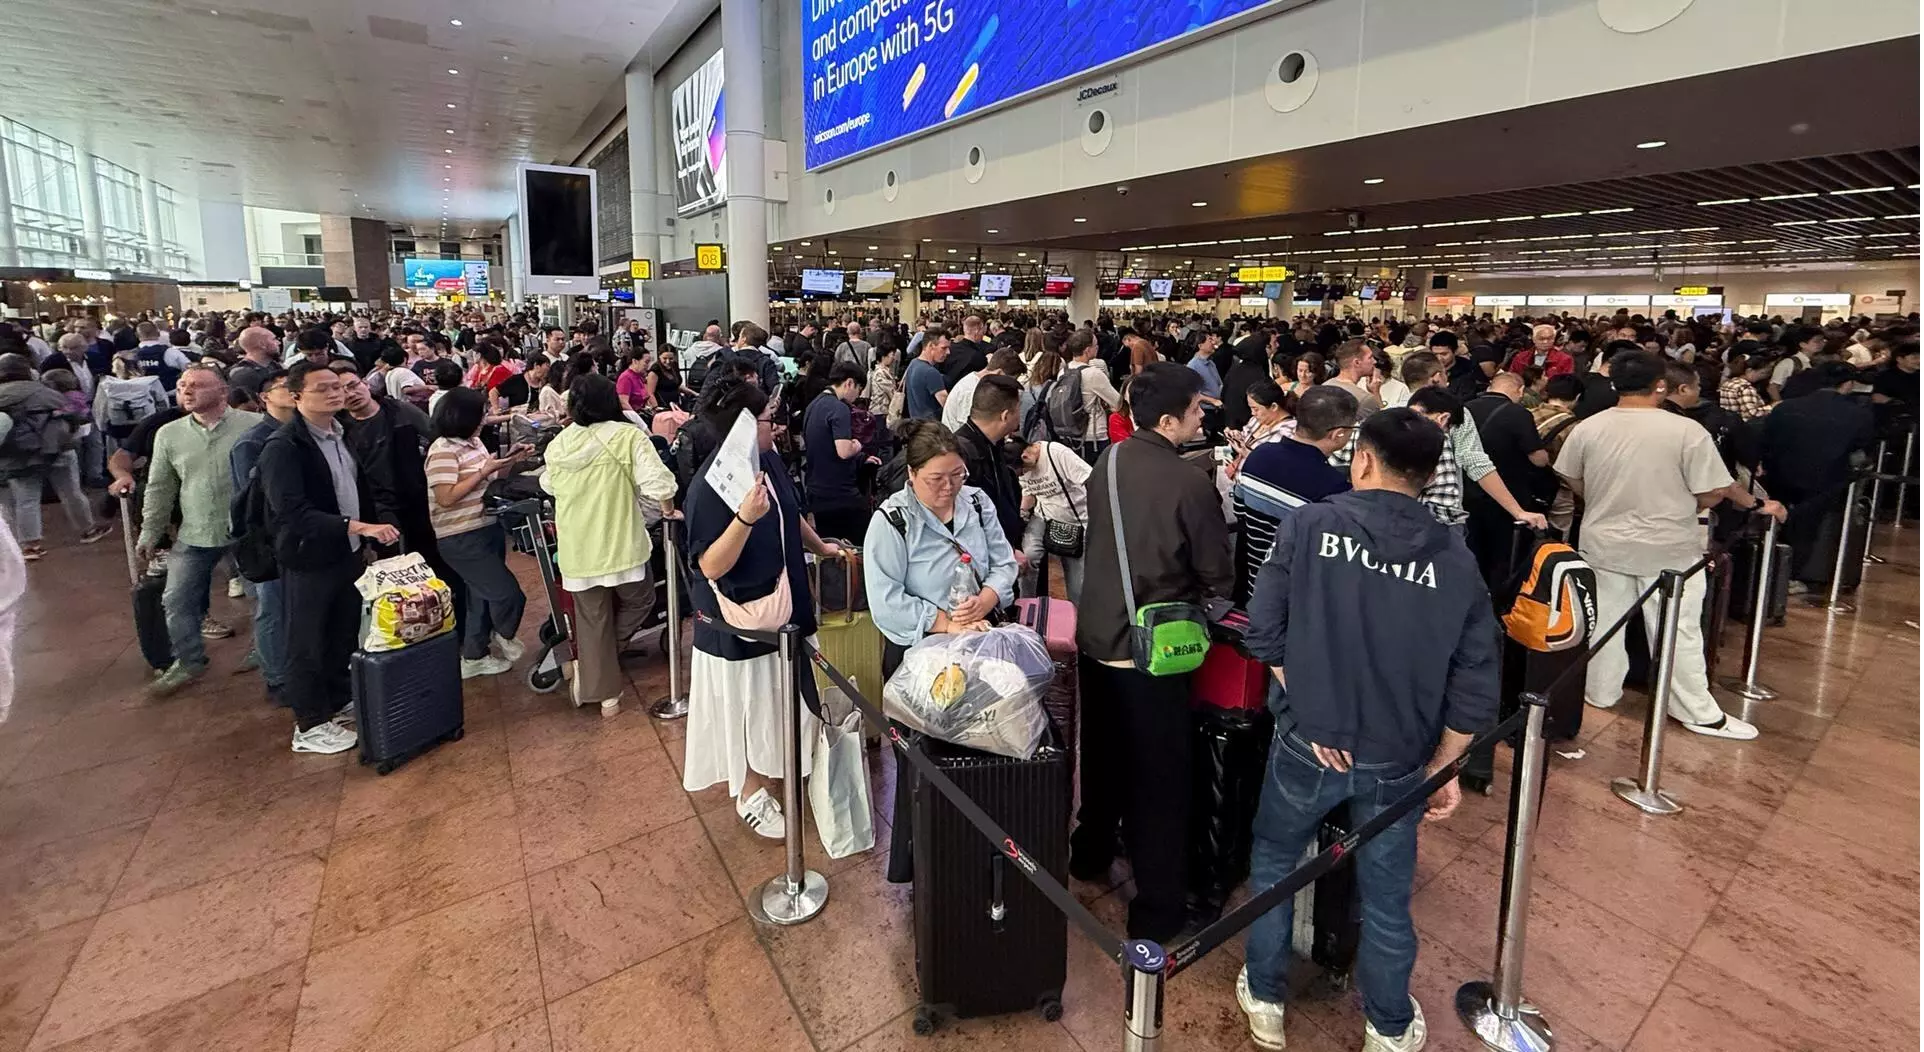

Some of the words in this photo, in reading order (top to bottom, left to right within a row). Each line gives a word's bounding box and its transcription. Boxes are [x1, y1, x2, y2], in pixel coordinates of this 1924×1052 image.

[812, 18, 837, 61] and
[813, 73, 825, 102] in
[827, 46, 878, 94] Europe
[880, 15, 919, 65] with
[924, 0, 954, 42] 5G
[1077, 82, 1118, 101] JCDecaux
[814, 112, 871, 144] ericsson.com/europe
[702, 253, 717, 266] 08
[633, 266, 646, 276] 07
[1135, 943, 1150, 959] 9
